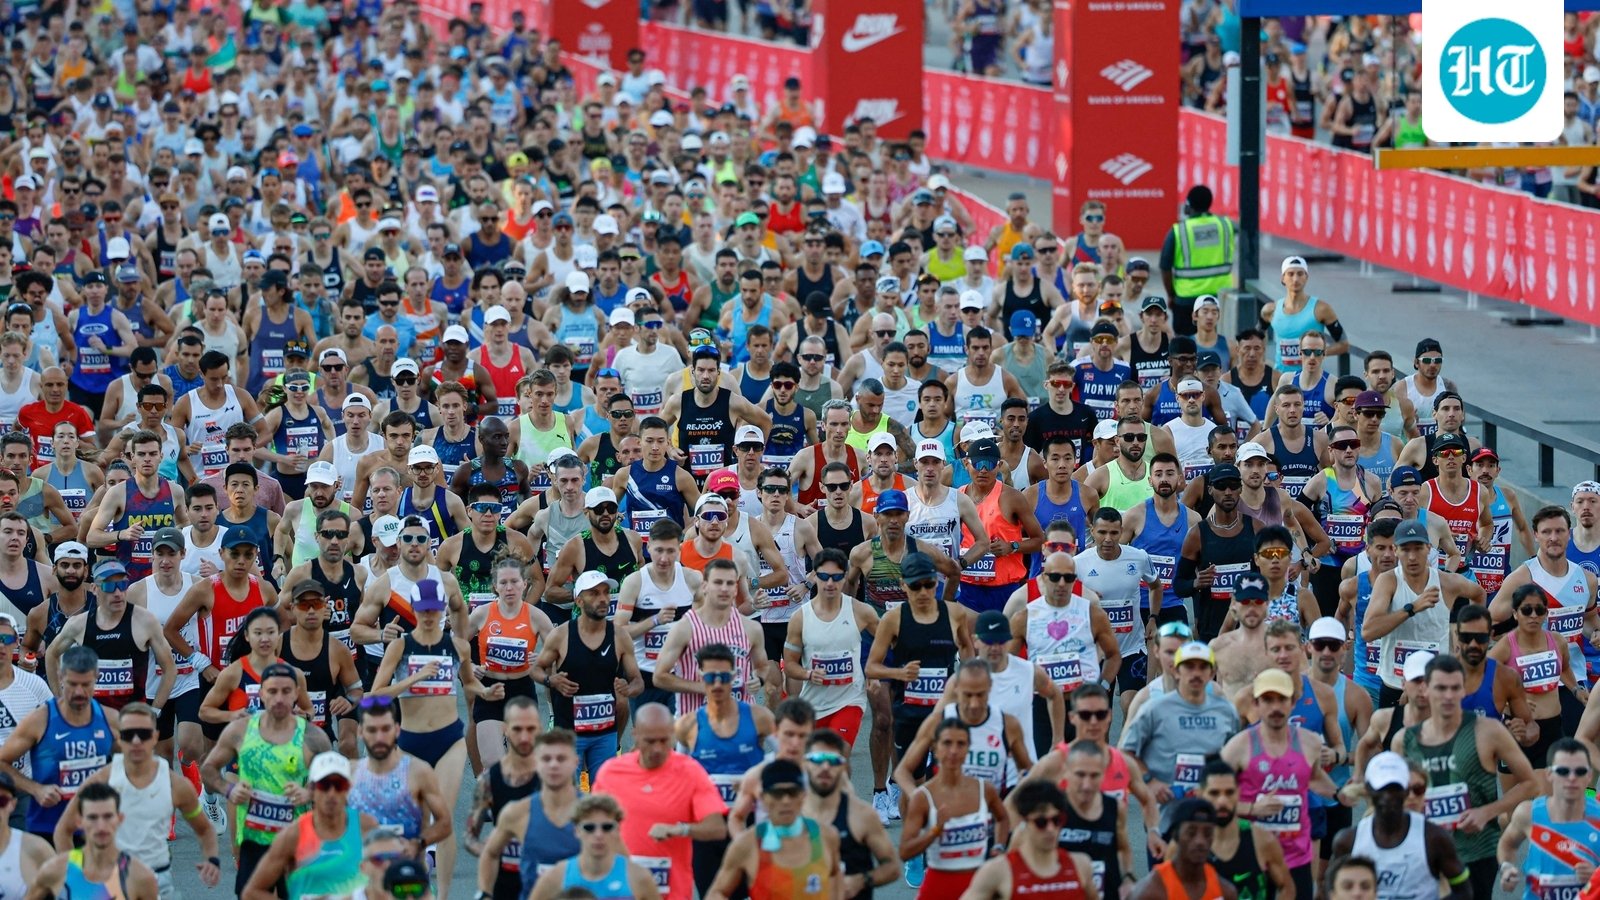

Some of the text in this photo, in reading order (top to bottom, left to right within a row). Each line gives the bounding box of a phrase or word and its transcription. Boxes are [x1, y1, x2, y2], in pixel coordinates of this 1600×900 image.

[1084, 383, 1117, 395] NORWA
[632, 392, 662, 405] A1723
[498, 406, 515, 415] 035
[1096, 409, 1115, 418] 2019
[39, 443, 54, 456] A22
[204, 451, 229, 465] A901
[692, 453, 722, 465] A1102
[128, 514, 173, 528] MNTC
[910, 524, 949, 536] STRIDERS
[1328, 525, 1362, 535] A21096
[134, 542, 152, 551] A10
[1109, 609, 1132, 621] 0151
[1551, 617, 1583, 631] A14073
[96, 632, 121, 641] saucony
[488, 648, 525, 661] A20042
[97, 671, 132, 683] 20162
[1047, 664, 1080, 678] 18044
[1523, 663, 1558, 680] A2157
[907, 678, 944, 692] A2102
[576, 703, 614, 719] A1700
[65, 741, 97, 760] USA
[1177, 768, 1199, 781] A21
[250, 804, 294, 821] A10196
[1425, 797, 1467, 817] A5151
